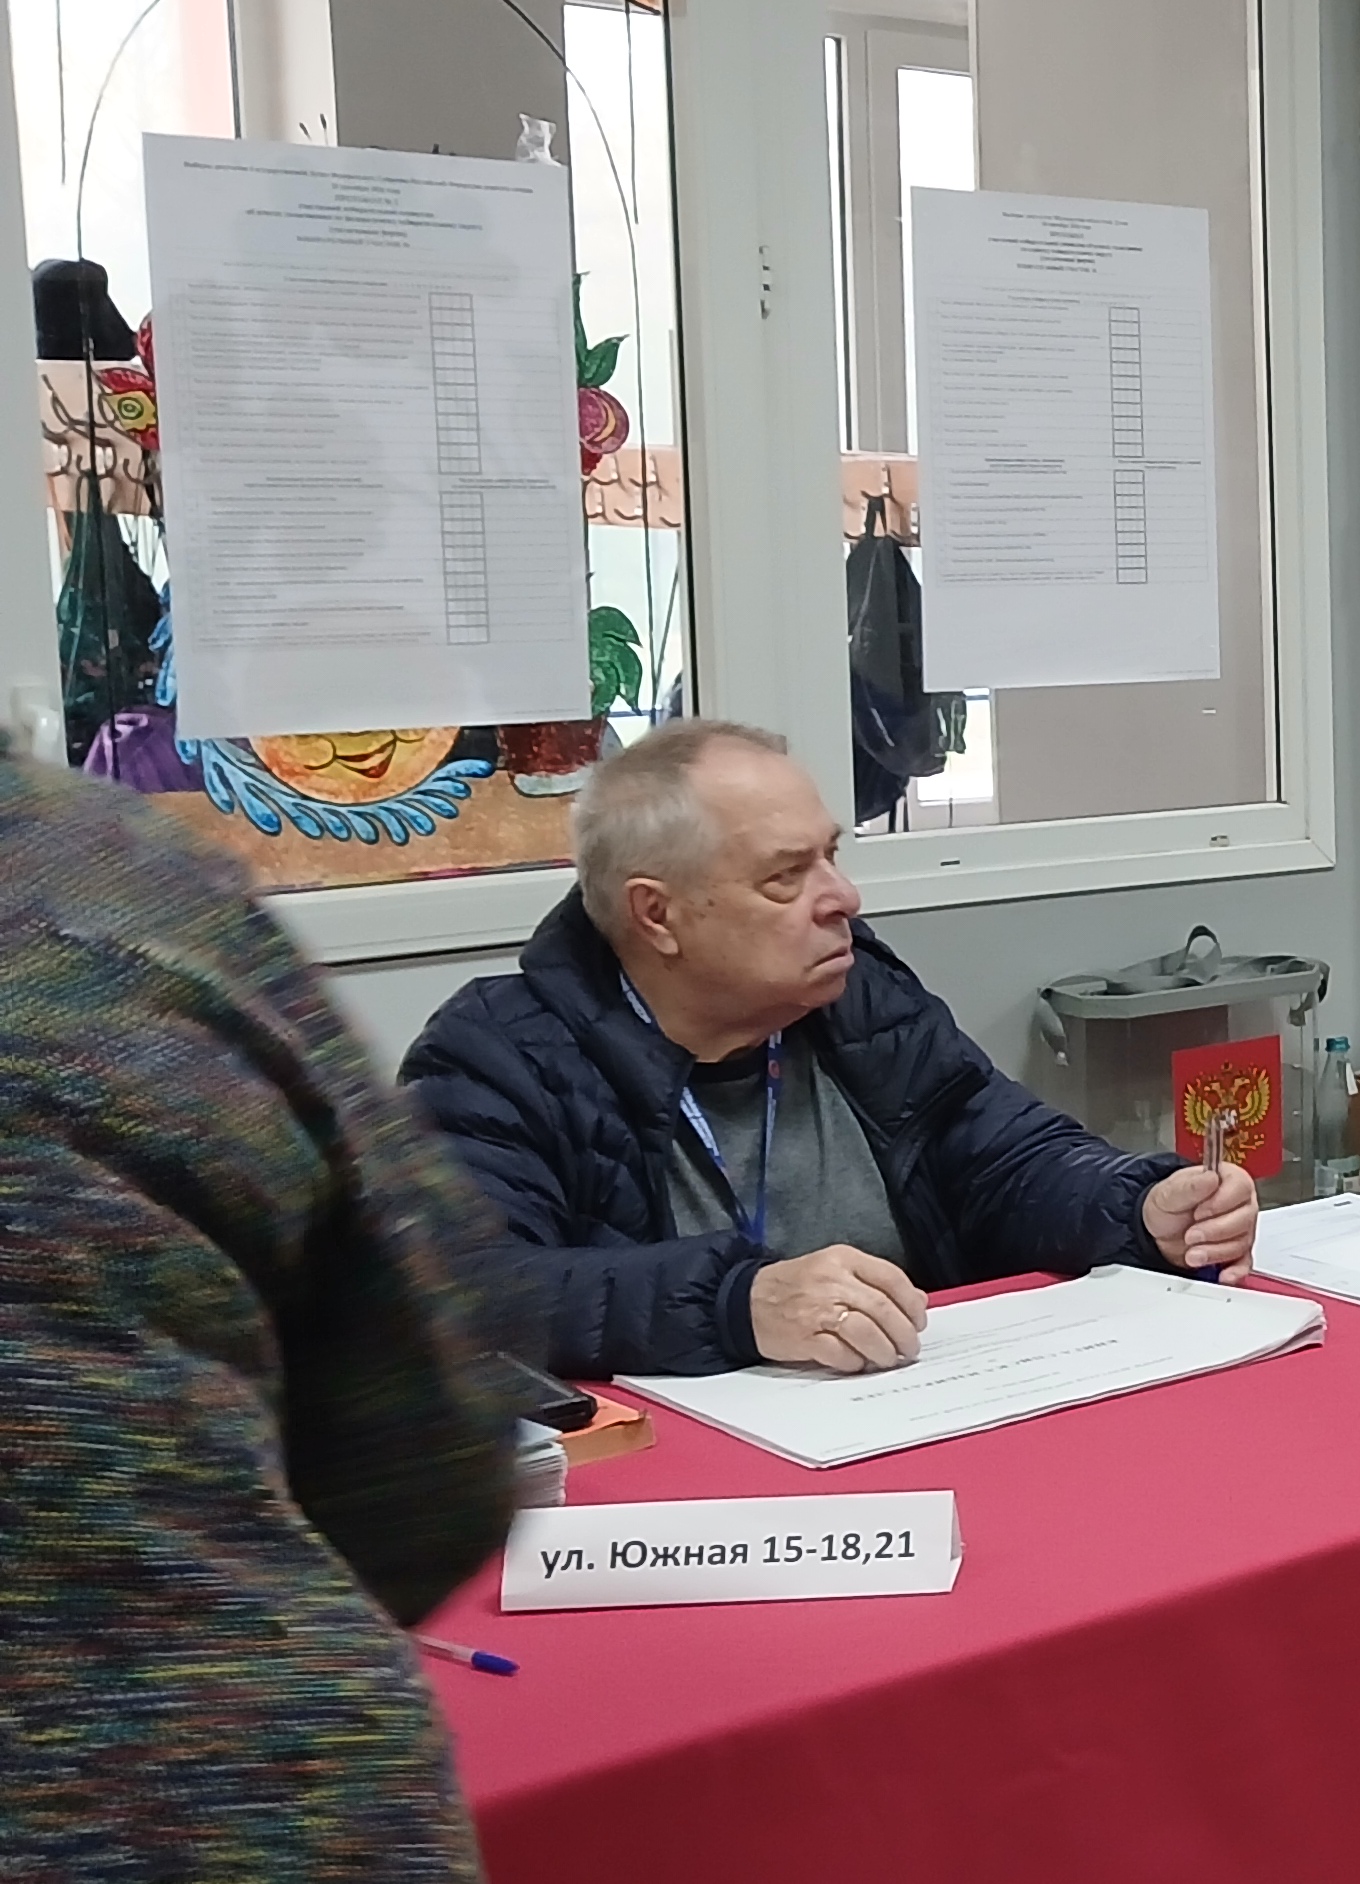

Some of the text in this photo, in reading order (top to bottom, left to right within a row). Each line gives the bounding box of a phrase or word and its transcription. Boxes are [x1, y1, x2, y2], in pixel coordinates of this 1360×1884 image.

[540, 1530, 915, 1579] ул. Южная 15-18,21
